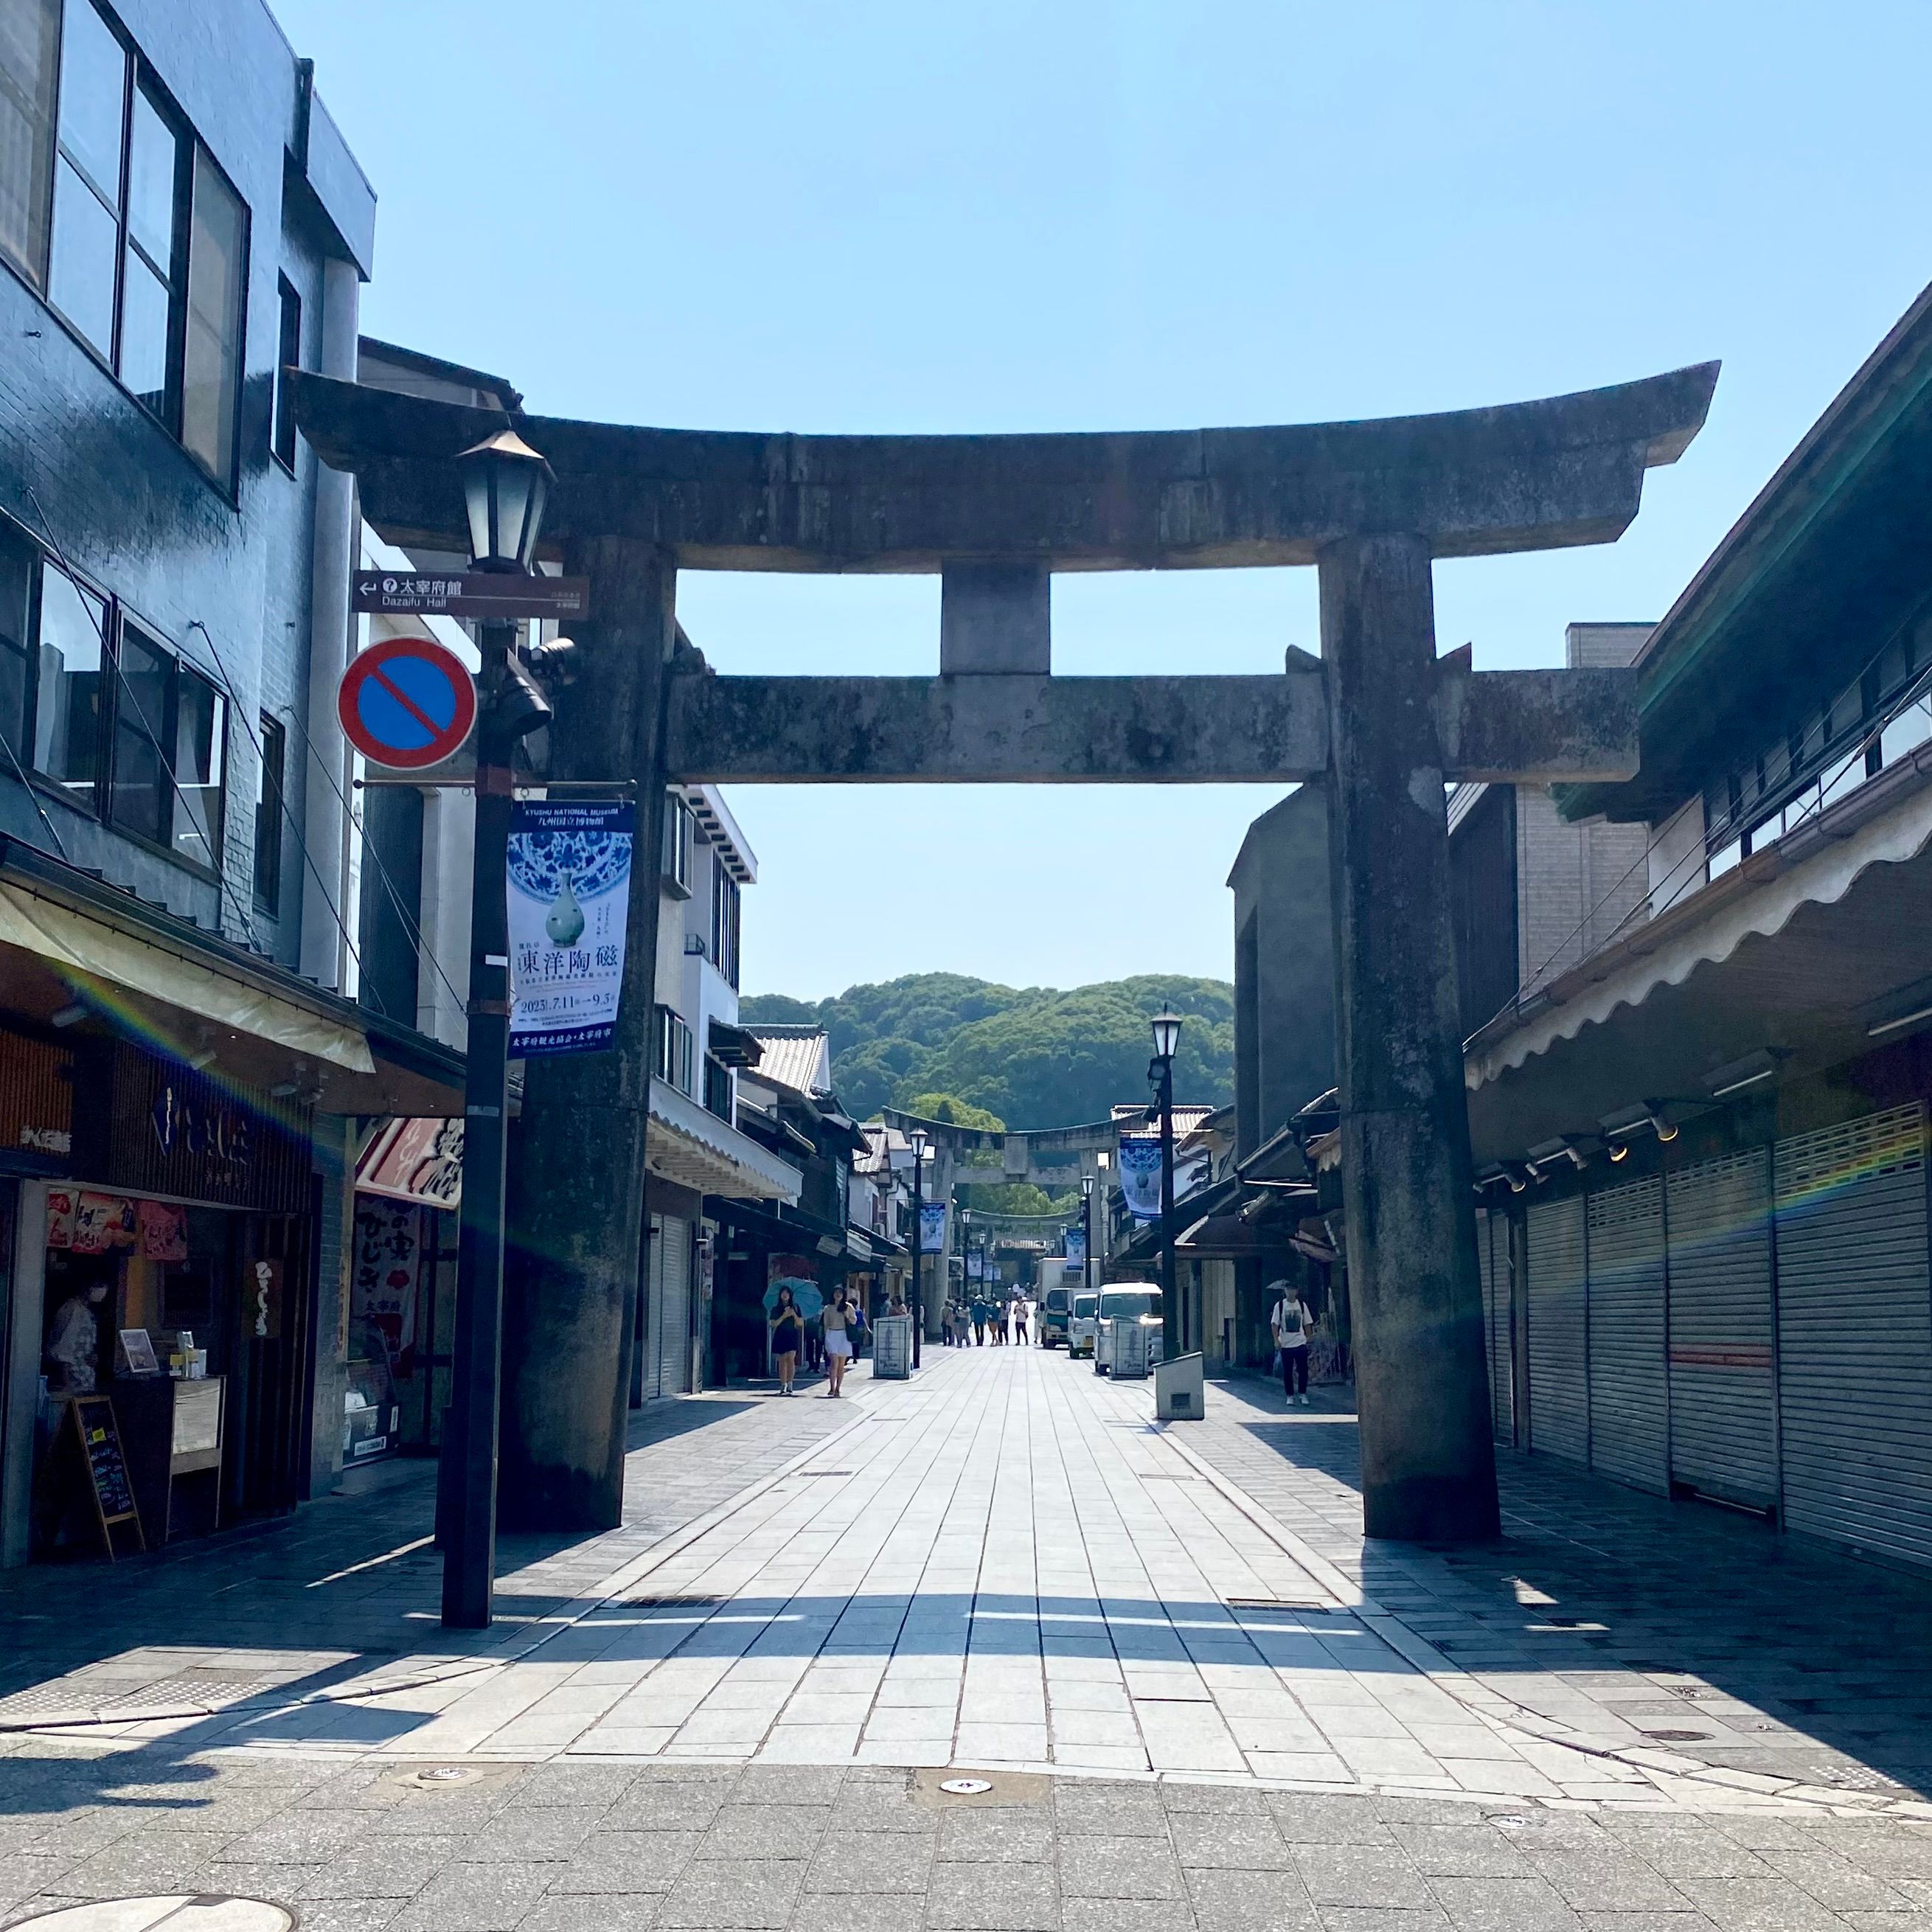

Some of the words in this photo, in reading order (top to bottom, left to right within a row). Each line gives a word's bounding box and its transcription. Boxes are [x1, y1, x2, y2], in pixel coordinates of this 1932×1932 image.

[400, 578, 462, 596] 太宰府館
[382, 596, 421, 607] Dazaifu
[426, 597, 447, 608] Hall
[521, 944, 619, 975] 東洋陶磁
